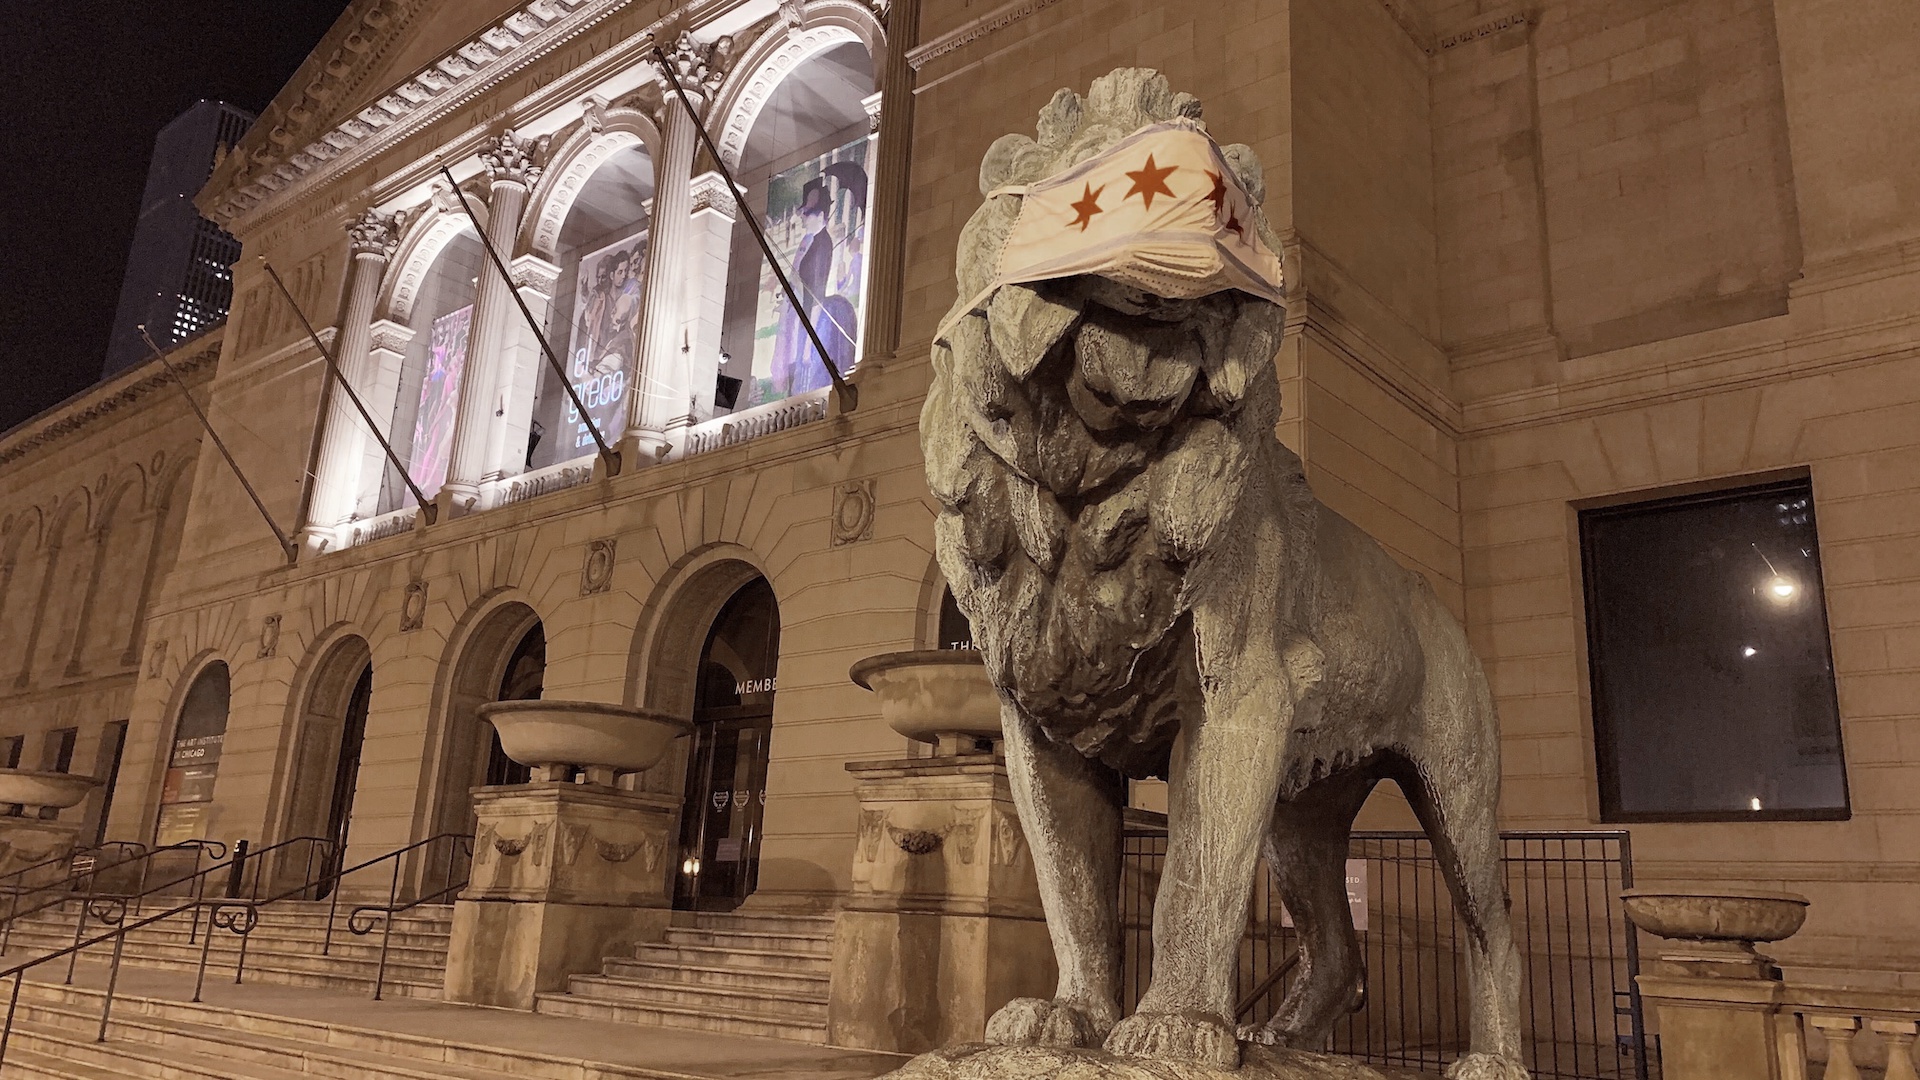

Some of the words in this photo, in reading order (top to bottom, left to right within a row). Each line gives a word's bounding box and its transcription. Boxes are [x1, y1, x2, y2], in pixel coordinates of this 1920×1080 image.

[574, 334, 592, 378] el
[567, 370, 624, 424] greco
[181, 748, 205, 759] CHICAGO
[187, 738, 197, 746] ART
